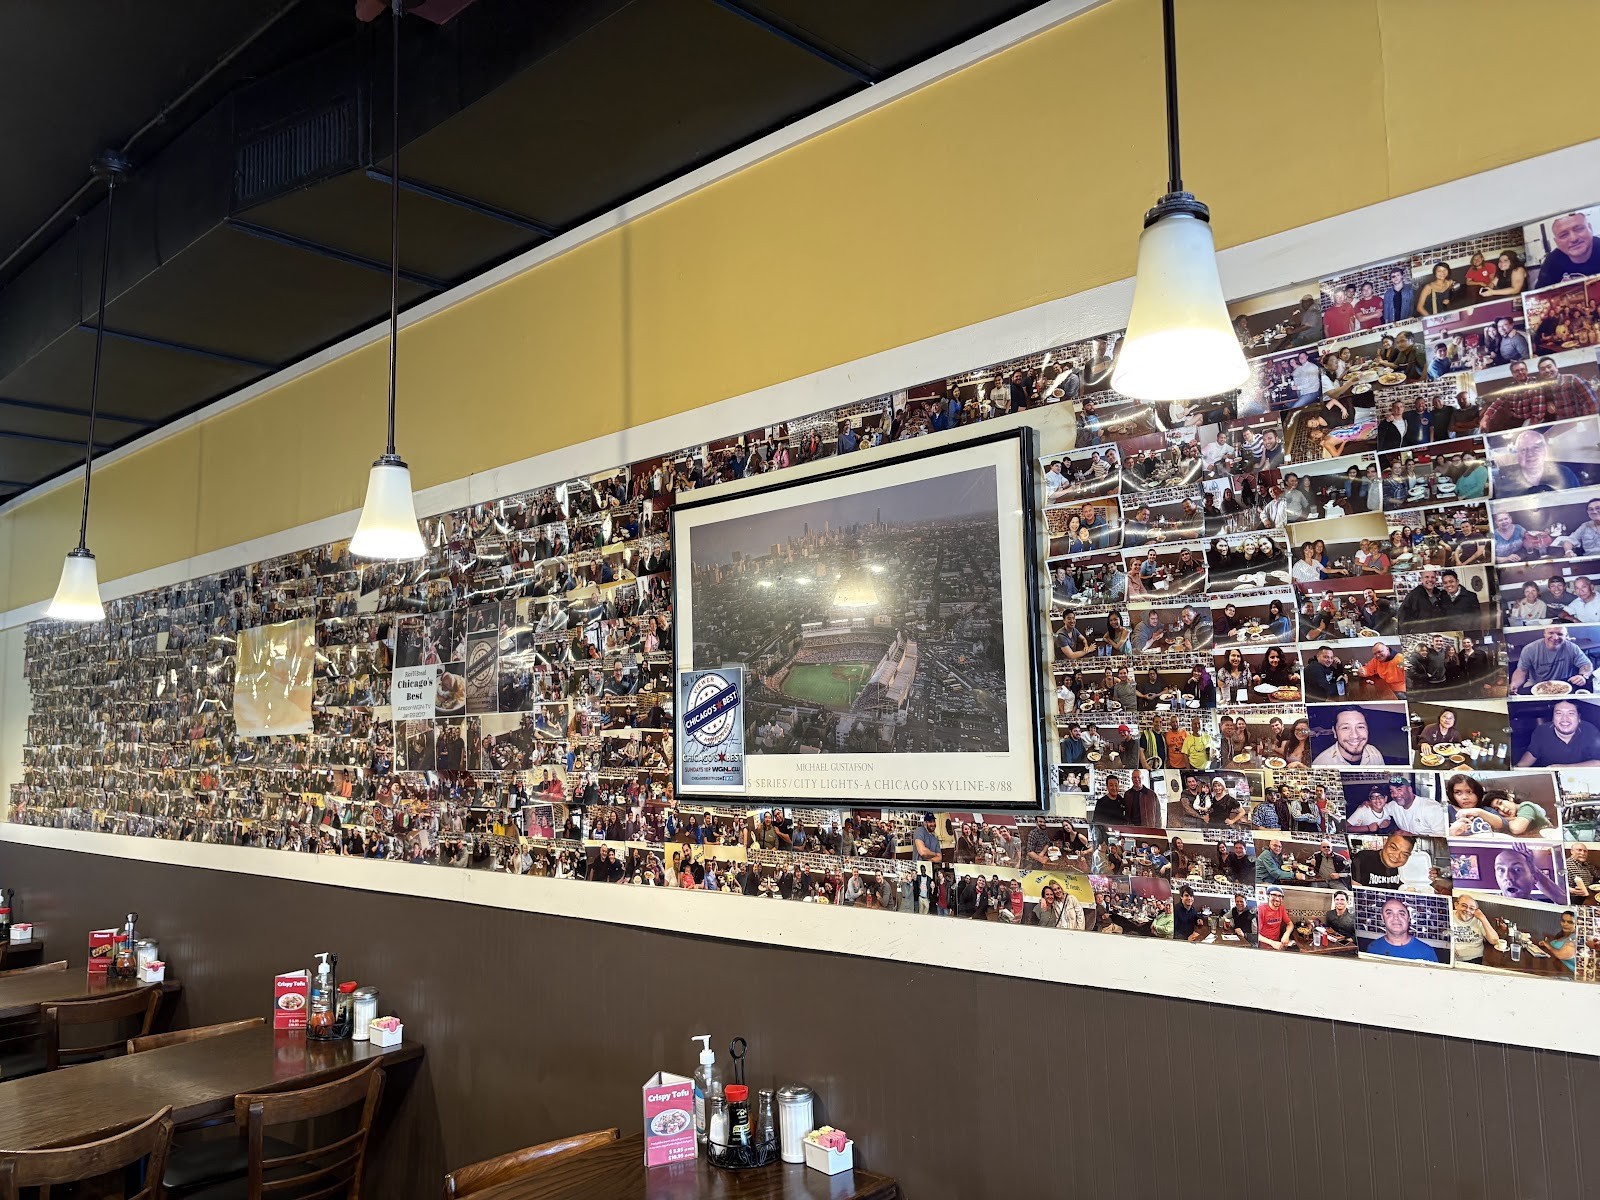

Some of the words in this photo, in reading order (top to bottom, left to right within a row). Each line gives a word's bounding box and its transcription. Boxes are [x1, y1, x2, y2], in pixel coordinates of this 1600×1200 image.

[397, 677, 433, 689] Chicago's
[693, 677, 715, 693] VIEWER
[406, 691, 423, 701] Best
[685, 704, 717, 728] CHICAGO'S
[722, 691, 737, 706] BEST
[682, 752, 719, 763] CHICAGO'S
[725, 752, 743, 763] BEST
[796, 763, 828, 772] MICHAEL
[830, 762, 874, 772] GUSTAFSON
[874, 779, 929, 790] CHICAGO
[648, 1093, 671, 1103] Crispy
[671, 1088, 690, 1098] Tofu
